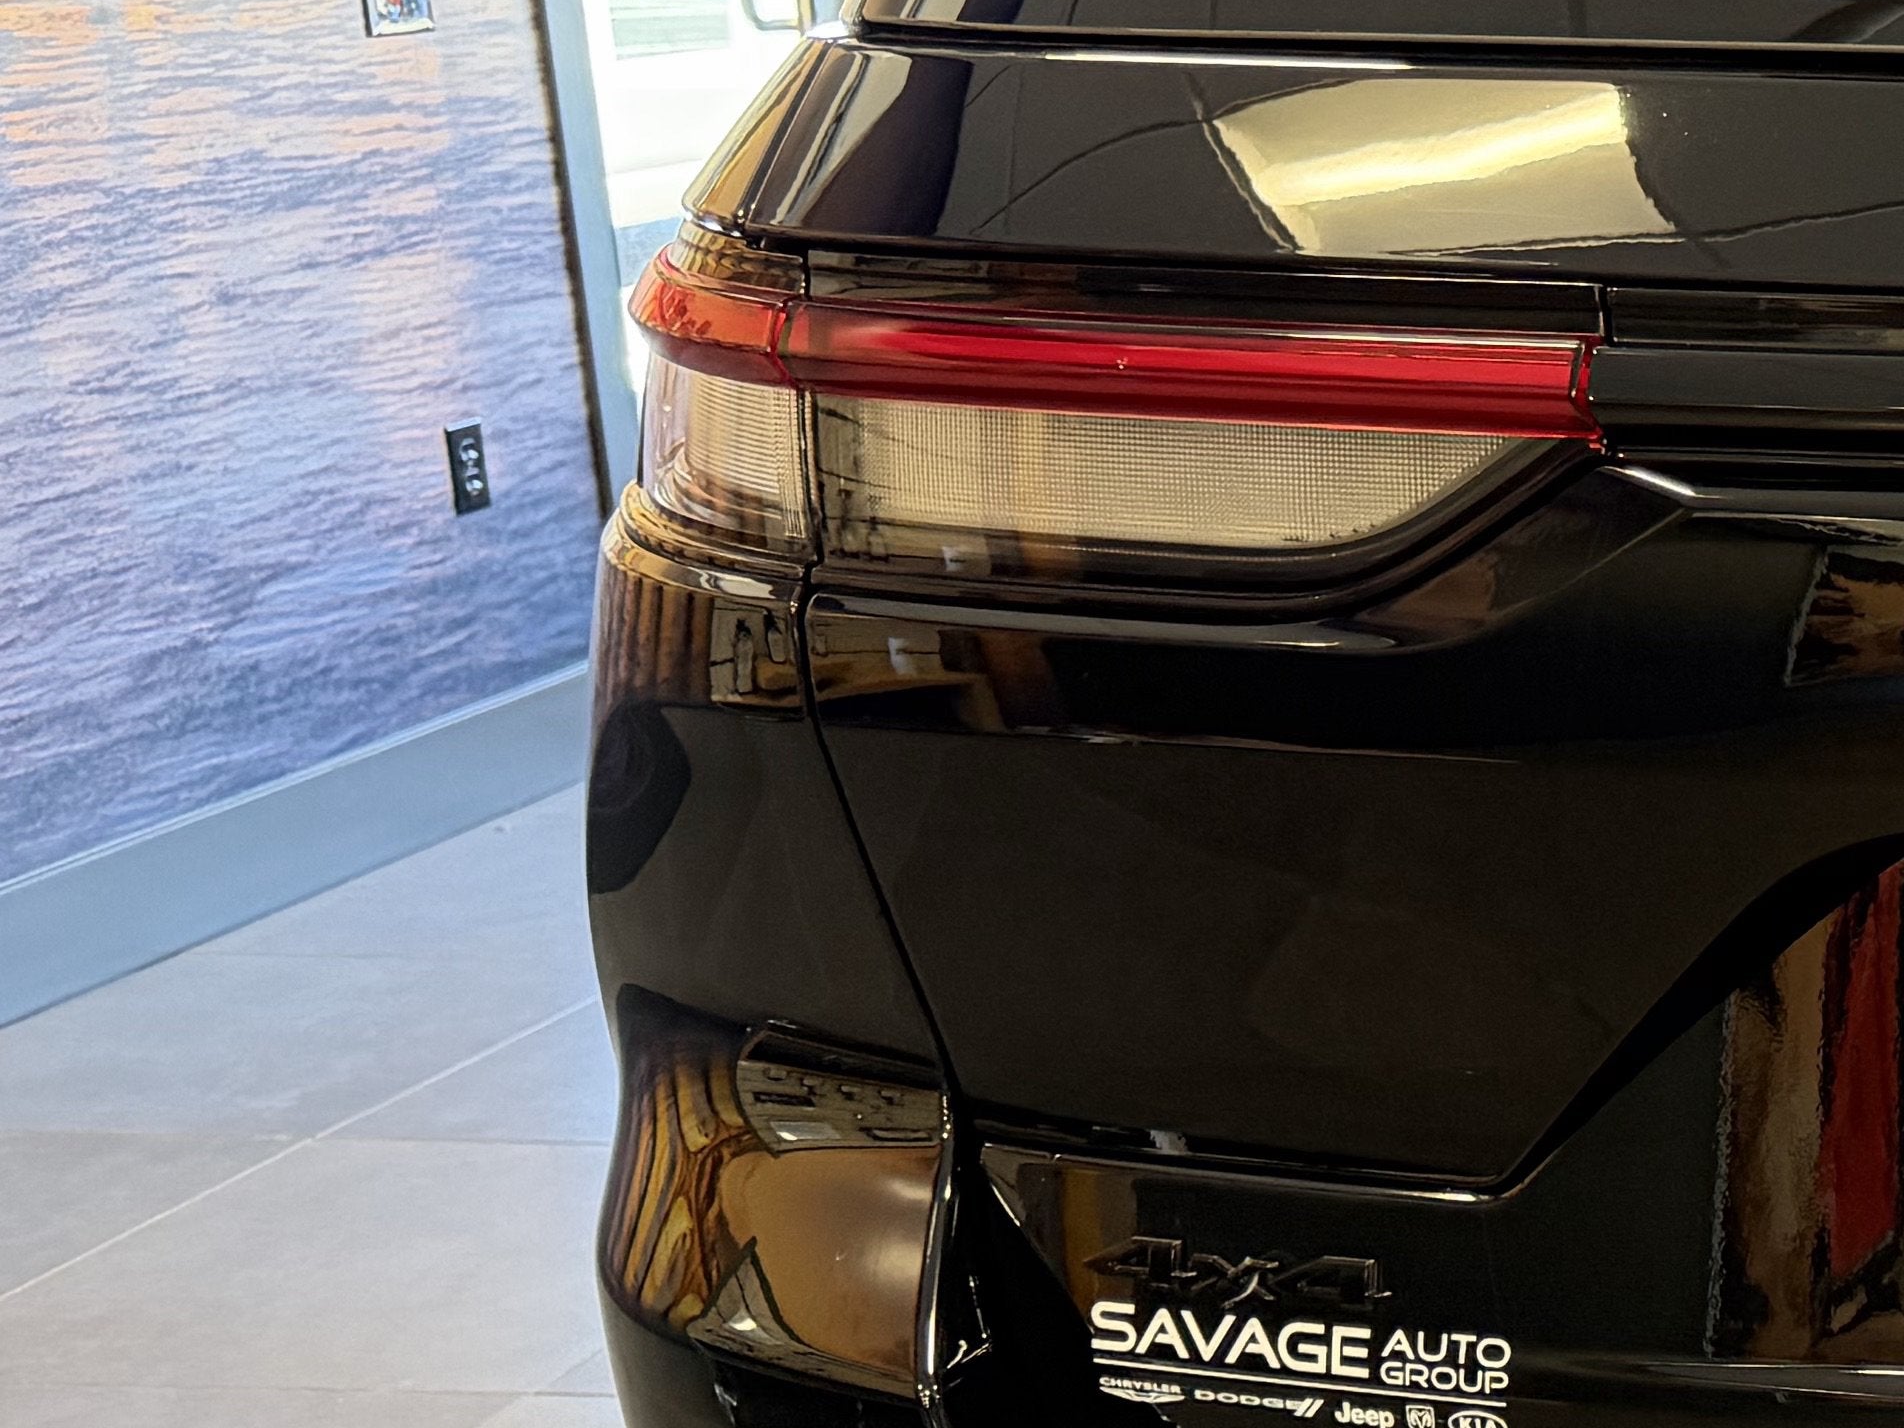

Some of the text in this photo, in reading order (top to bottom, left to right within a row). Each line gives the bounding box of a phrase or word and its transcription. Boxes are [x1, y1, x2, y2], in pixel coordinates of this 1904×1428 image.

[1091, 1301, 1512, 1378] SAVAGE AUTO
[1099, 1377, 1182, 1394] CHRYSLER
[1194, 1389, 1312, 1412] DODGE
[1379, 1360, 1510, 1395] GROUP
